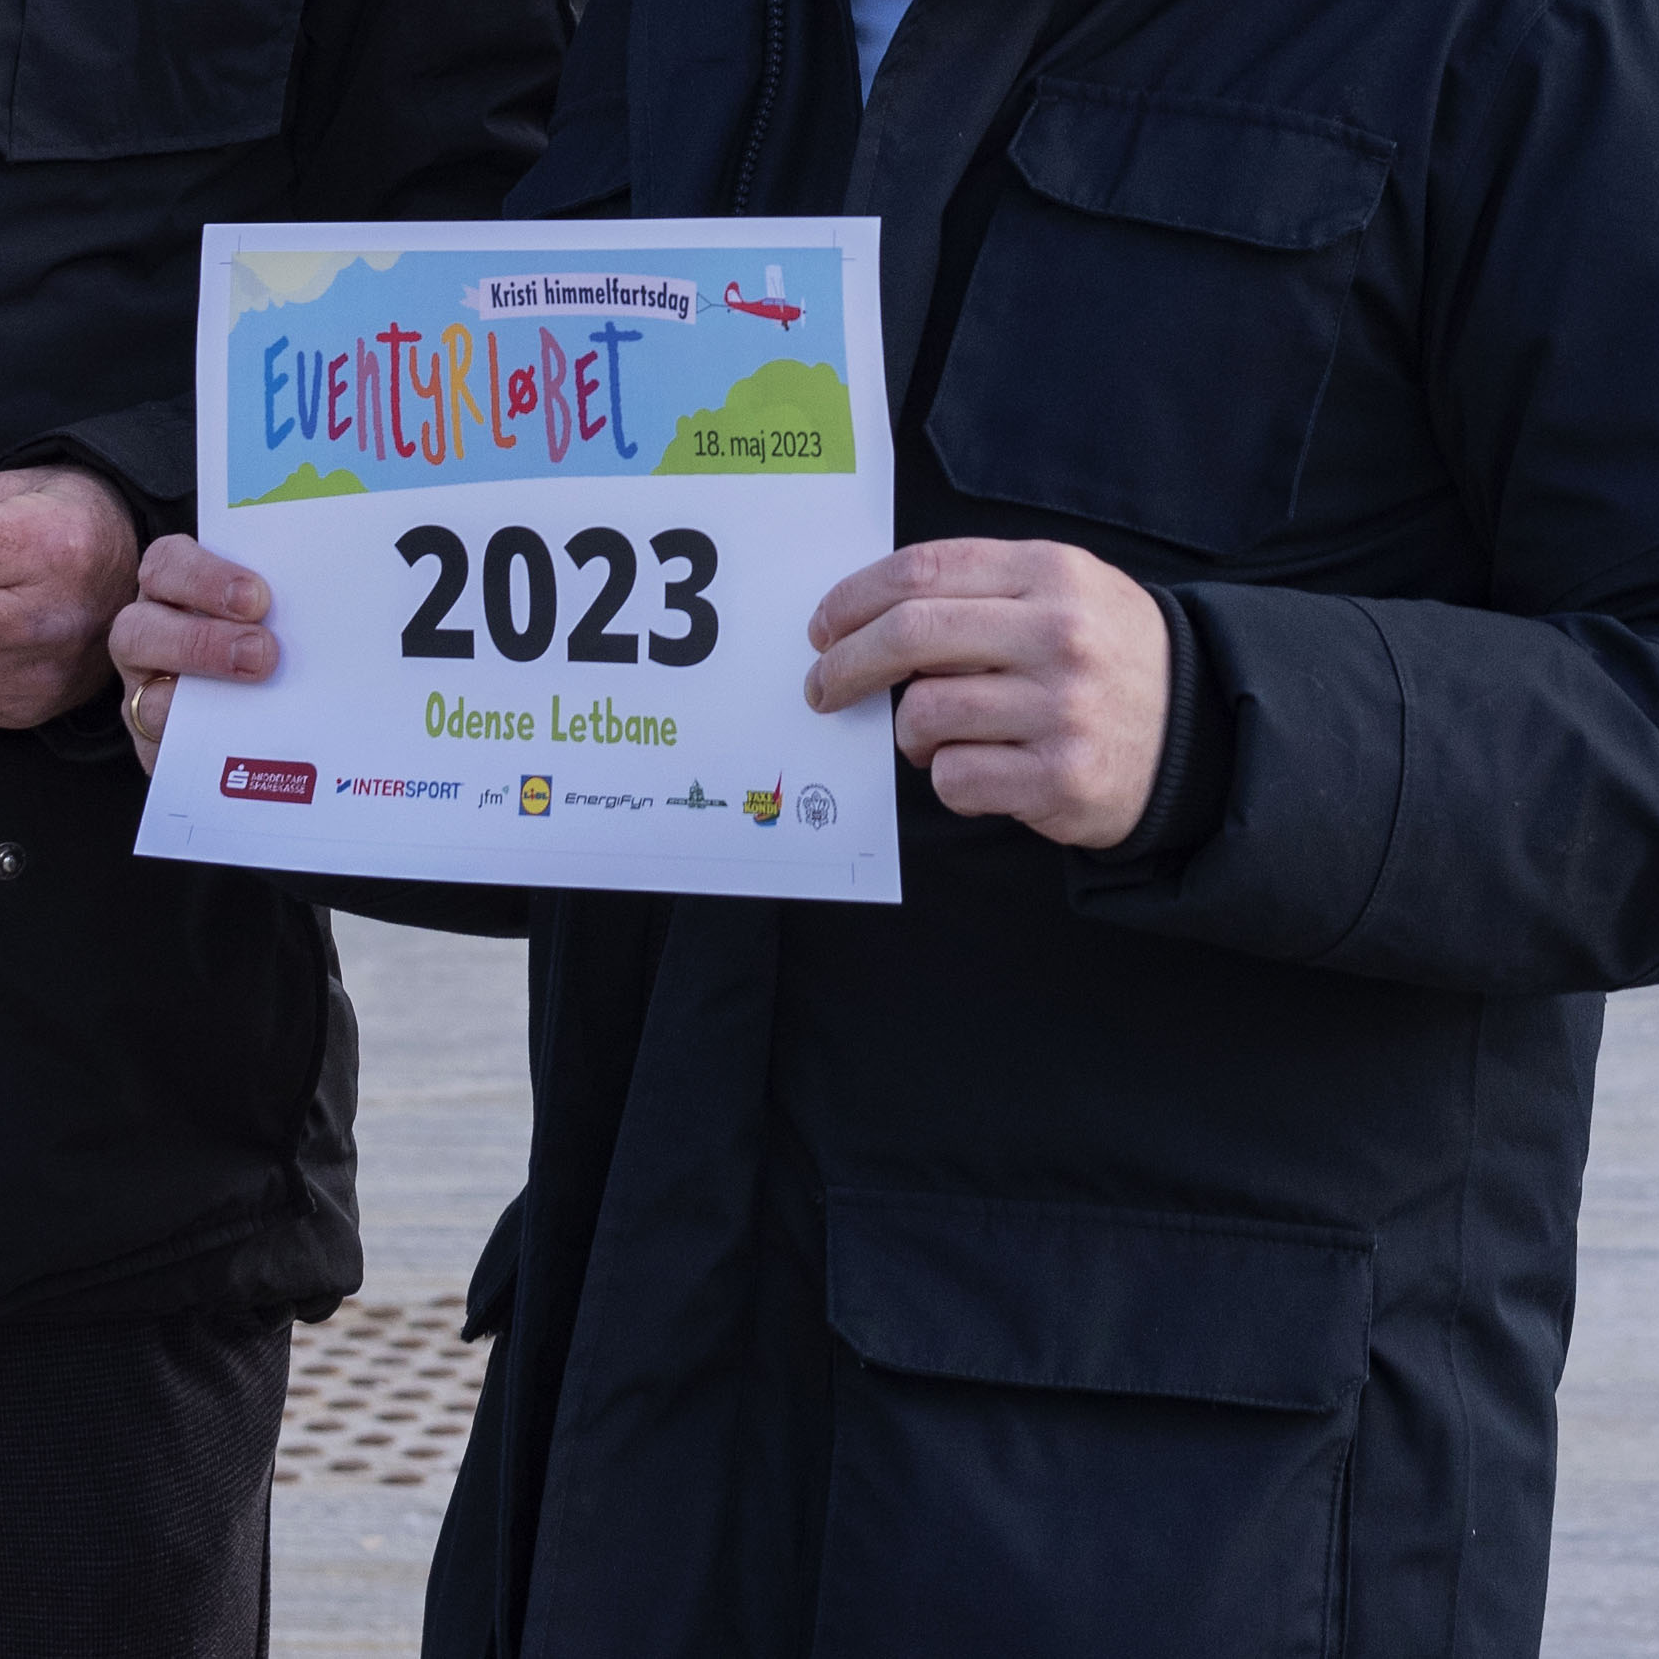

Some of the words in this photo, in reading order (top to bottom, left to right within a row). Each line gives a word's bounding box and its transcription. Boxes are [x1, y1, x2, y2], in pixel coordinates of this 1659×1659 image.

[491, 280, 538, 309] Kristi
[544, 277, 690, 320] himmelfartsdag
[694, 430, 725, 457] 18.
[730, 430, 766, 461] maj
[770, 430, 823, 458] 2023
[394, 524, 719, 668] 2023
[425, 691, 535, 742] Odense
[551, 694, 678, 746] Letbane
[352, 778, 463, 799] INTERSPORT
[478, 789, 503, 809] jfm
